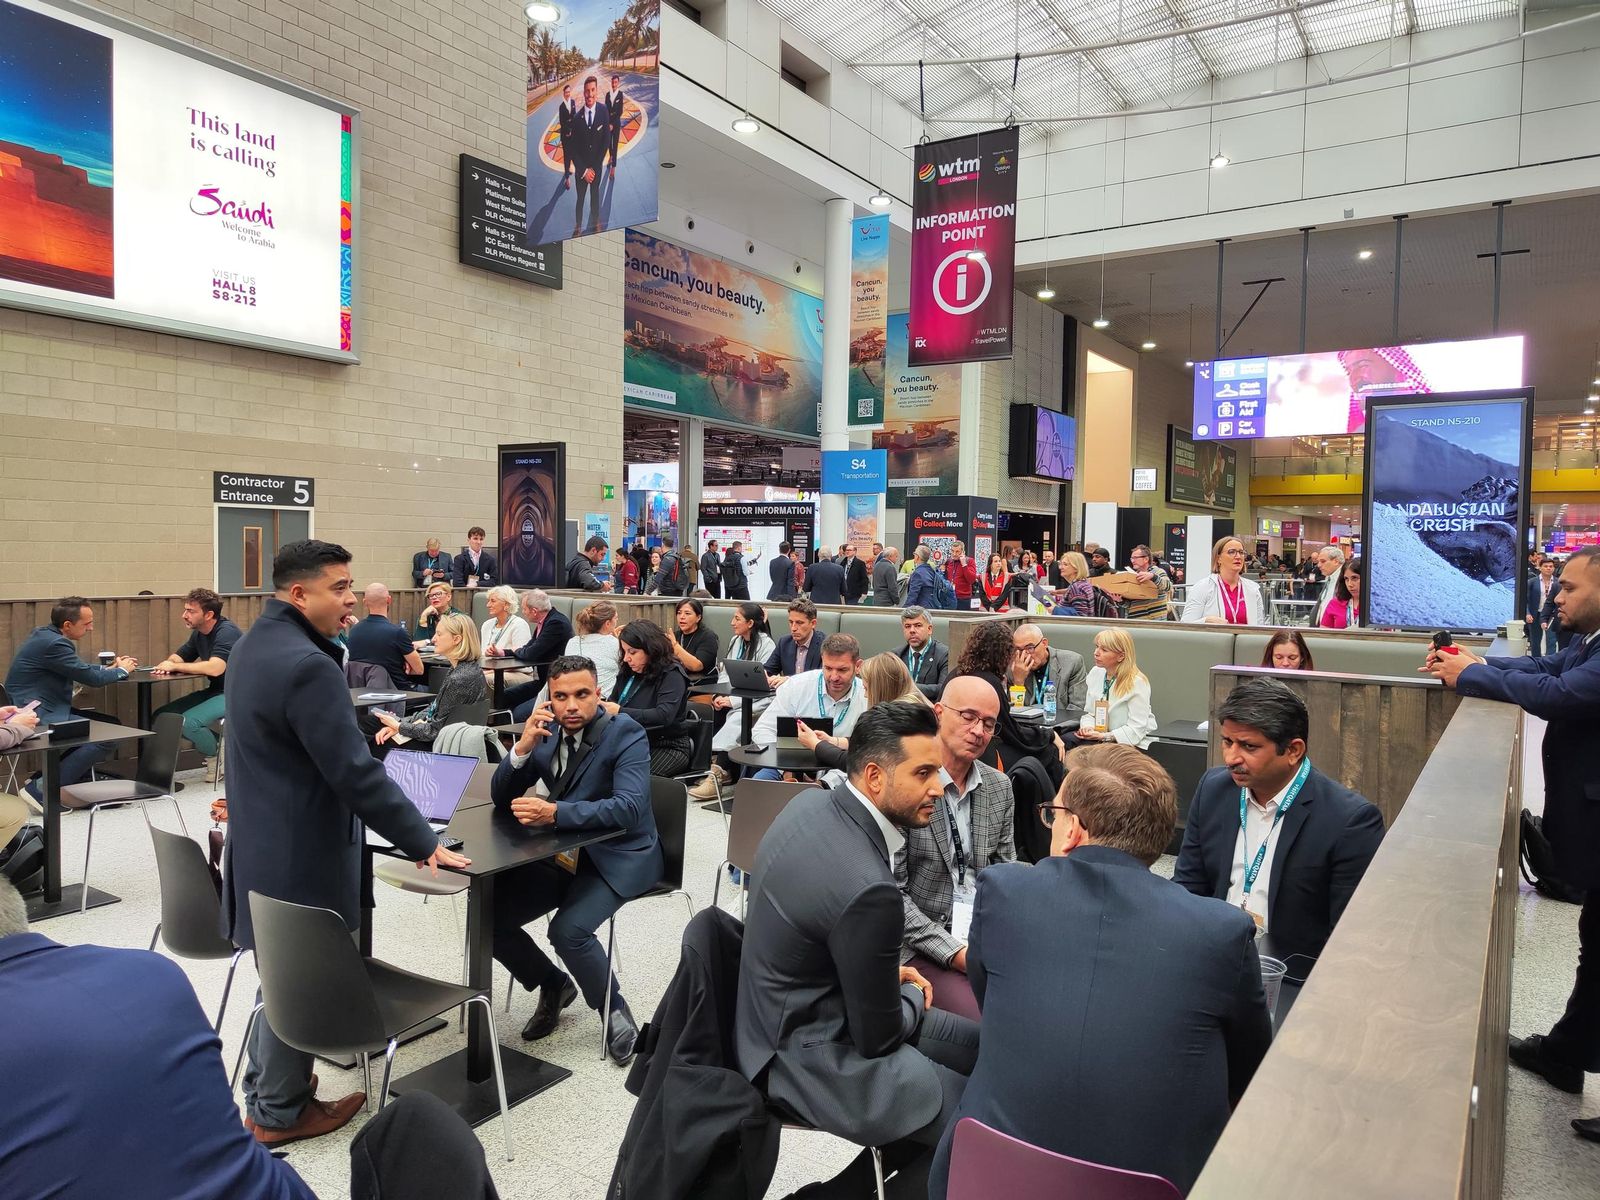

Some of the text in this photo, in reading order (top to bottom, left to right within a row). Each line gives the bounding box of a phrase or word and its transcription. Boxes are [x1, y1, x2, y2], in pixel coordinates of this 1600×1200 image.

[186, 106, 275, 151] This land
[190, 132, 276, 178] is calling
[938, 157, 980, 177] wtm
[485, 177, 500, 188] Halls
[485, 188, 526, 208] Platinum Suite
[189, 187, 275, 229] Saudi
[485, 199, 526, 218] West Entrance
[485, 210, 498, 220] DLR
[499, 214, 520, 227] Custom
[916, 203, 1015, 230] INFORMATION
[221, 219, 261, 238] Welcome
[485, 226, 515, 241] Halls 5-12
[941, 225, 987, 243] POINT
[237, 233, 276, 249] to Arabia
[485, 236, 536, 257] ICC East Entrance
[485, 247, 538, 269] DLR Prince Regent
[212, 268, 256, 286] VISIT US
[855, 279, 883, 287] Cancun,
[212, 278, 256, 295] HALL 8
[862, 287, 875, 295] you
[631, 294, 658, 307] Mexican
[640, 284, 653, 295] hop
[654, 289, 682, 302] between
[682, 298, 700, 311] sandy
[700, 304, 728, 318] stretches
[687, 276, 713, 296] you
[717, 281, 765, 315] beauty.
[900, 375, 932, 383] Cancun,
[624, 386, 643, 394] EXICAN
[893, 384, 939, 395] you beauty.
[1238, 408, 1254, 416] Aid
[1411, 416, 1481, 427] STAND N5-210
[851, 459, 867, 470] S4
[220, 474, 285, 489] Contractor
[840, 472, 880, 480] Transportation
[220, 489, 274, 503] Entrance
[293, 480, 310, 504] 5
[721, 506, 753, 515] VISITOR
[754, 506, 813, 515] INFORMATION
[923, 511, 940, 519] Carry
[1384, 502, 1505, 518] ANDALUSIAN
[1410, 518, 1475, 532] CRUSH
